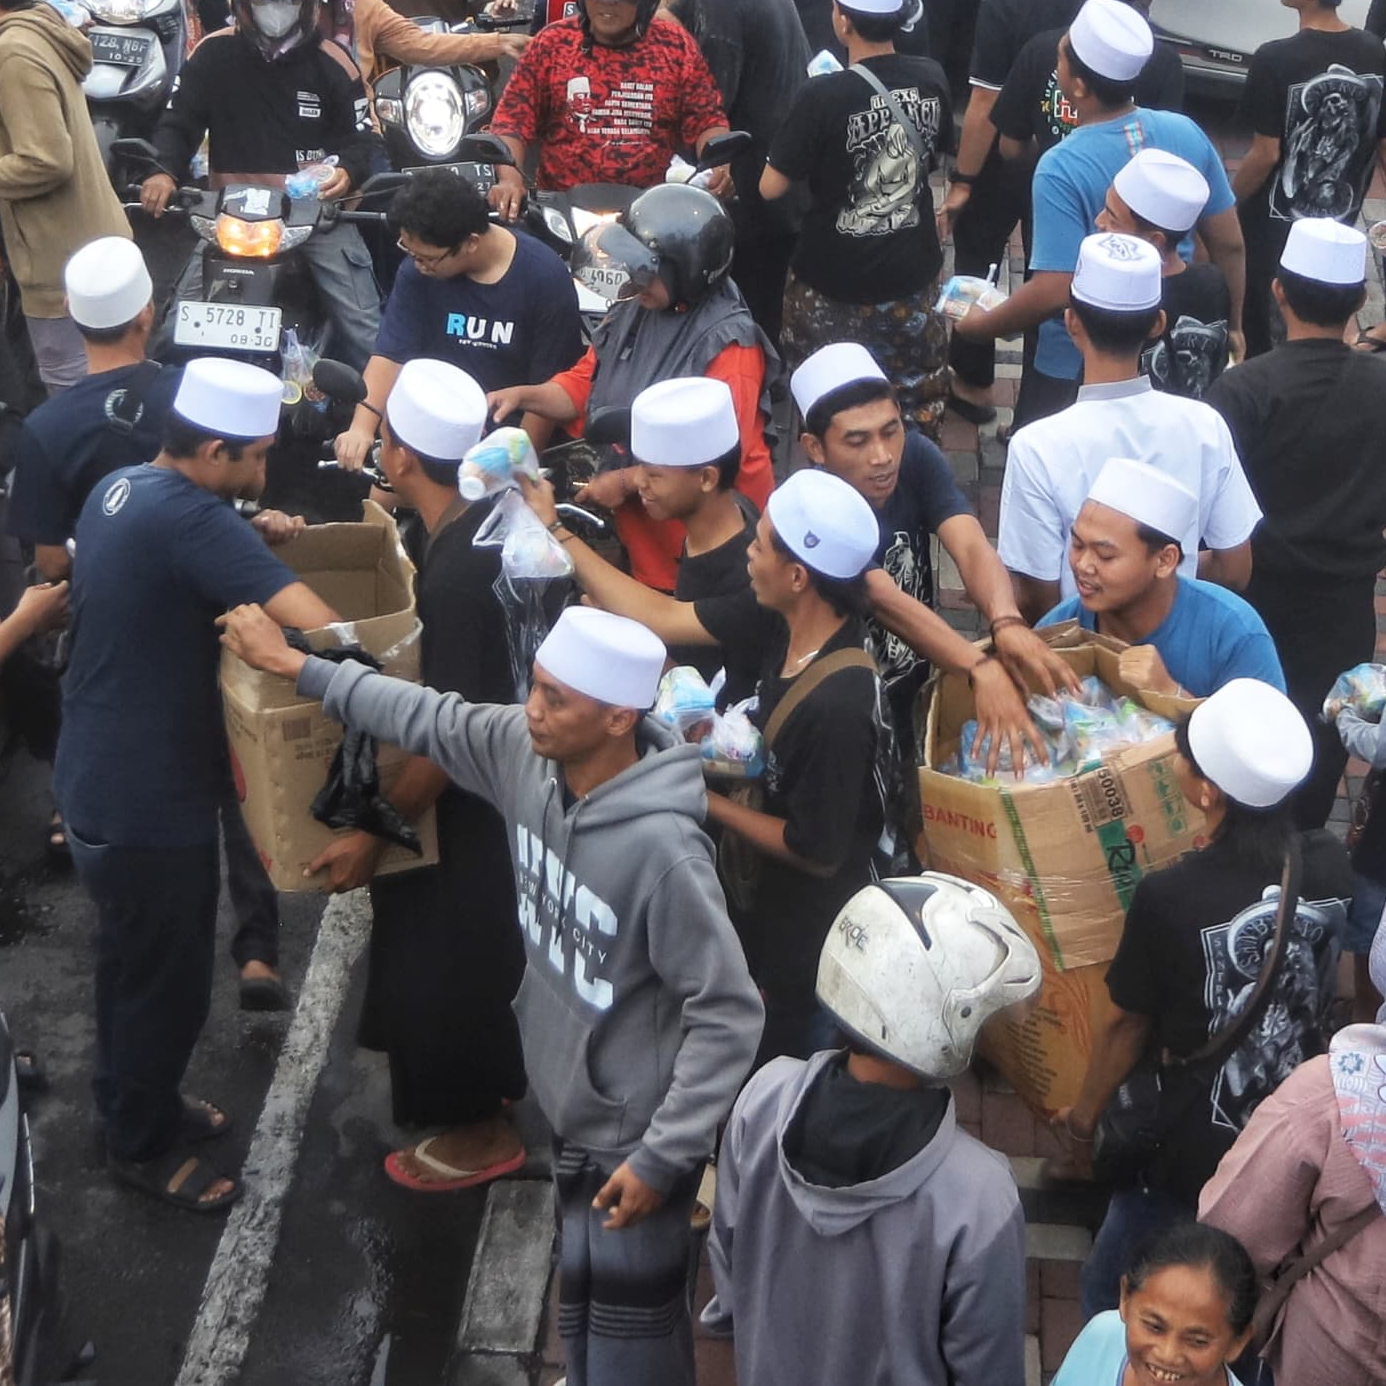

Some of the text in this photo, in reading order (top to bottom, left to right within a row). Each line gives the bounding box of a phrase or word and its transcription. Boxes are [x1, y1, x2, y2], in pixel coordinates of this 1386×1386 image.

[1209, 49, 1243, 63] TRD
[474, 164, 493, 177] TS
[181, 306, 190, 322] S
[206, 308, 245, 326] 5728
[446, 312, 515, 345] RUN
[1095, 768, 1124, 818] 50038
[923, 804, 998, 839] BANTING
[572, 927, 608, 965] CITY
